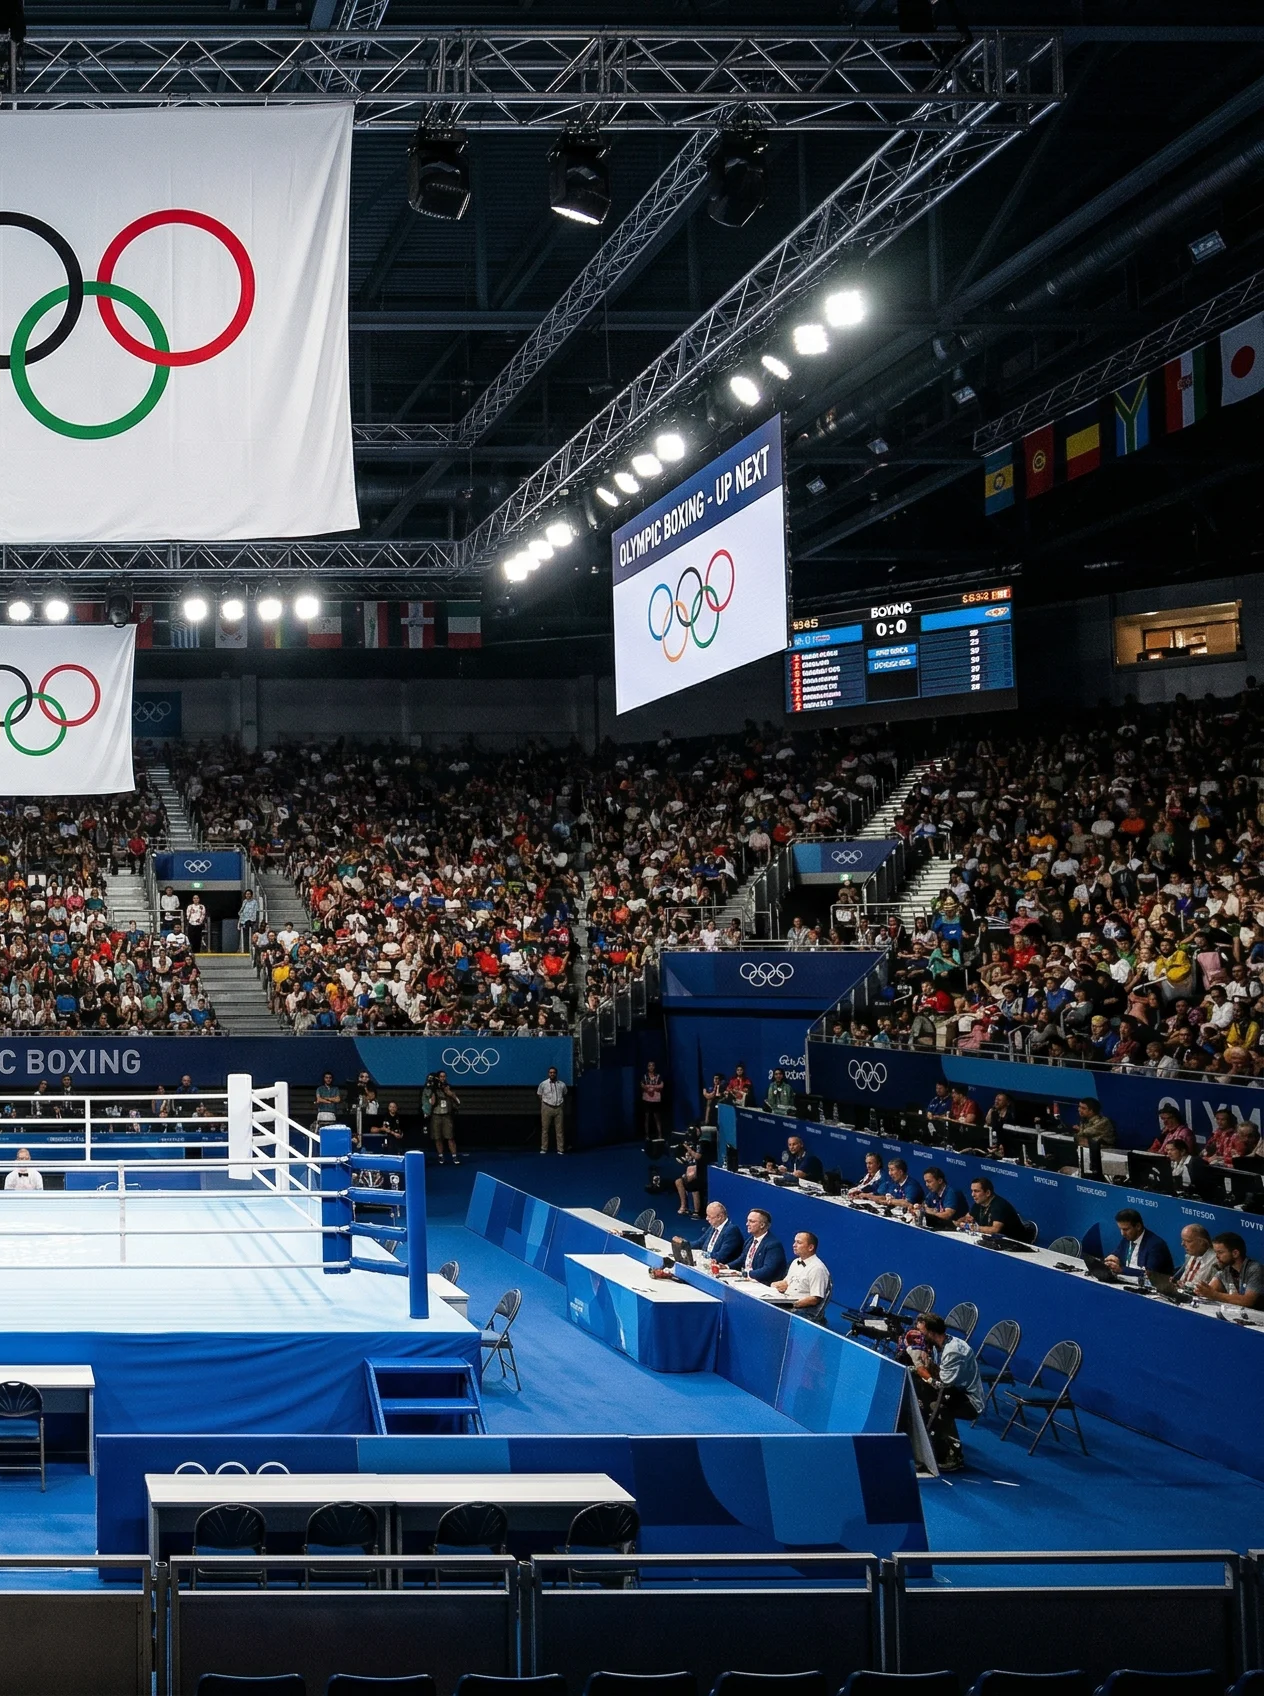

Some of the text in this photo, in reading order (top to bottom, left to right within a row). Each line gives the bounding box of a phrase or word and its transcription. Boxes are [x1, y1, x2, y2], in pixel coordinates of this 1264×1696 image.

[619, 519, 662, 568] OLYMPIC
[663, 490, 704, 541] BOXING
[715, 471, 732, 506] UP
[735, 444, 770, 495] NEXT
[876, 619, 907, 637] 0:0
[27, 1049, 141, 1075] BOXING
